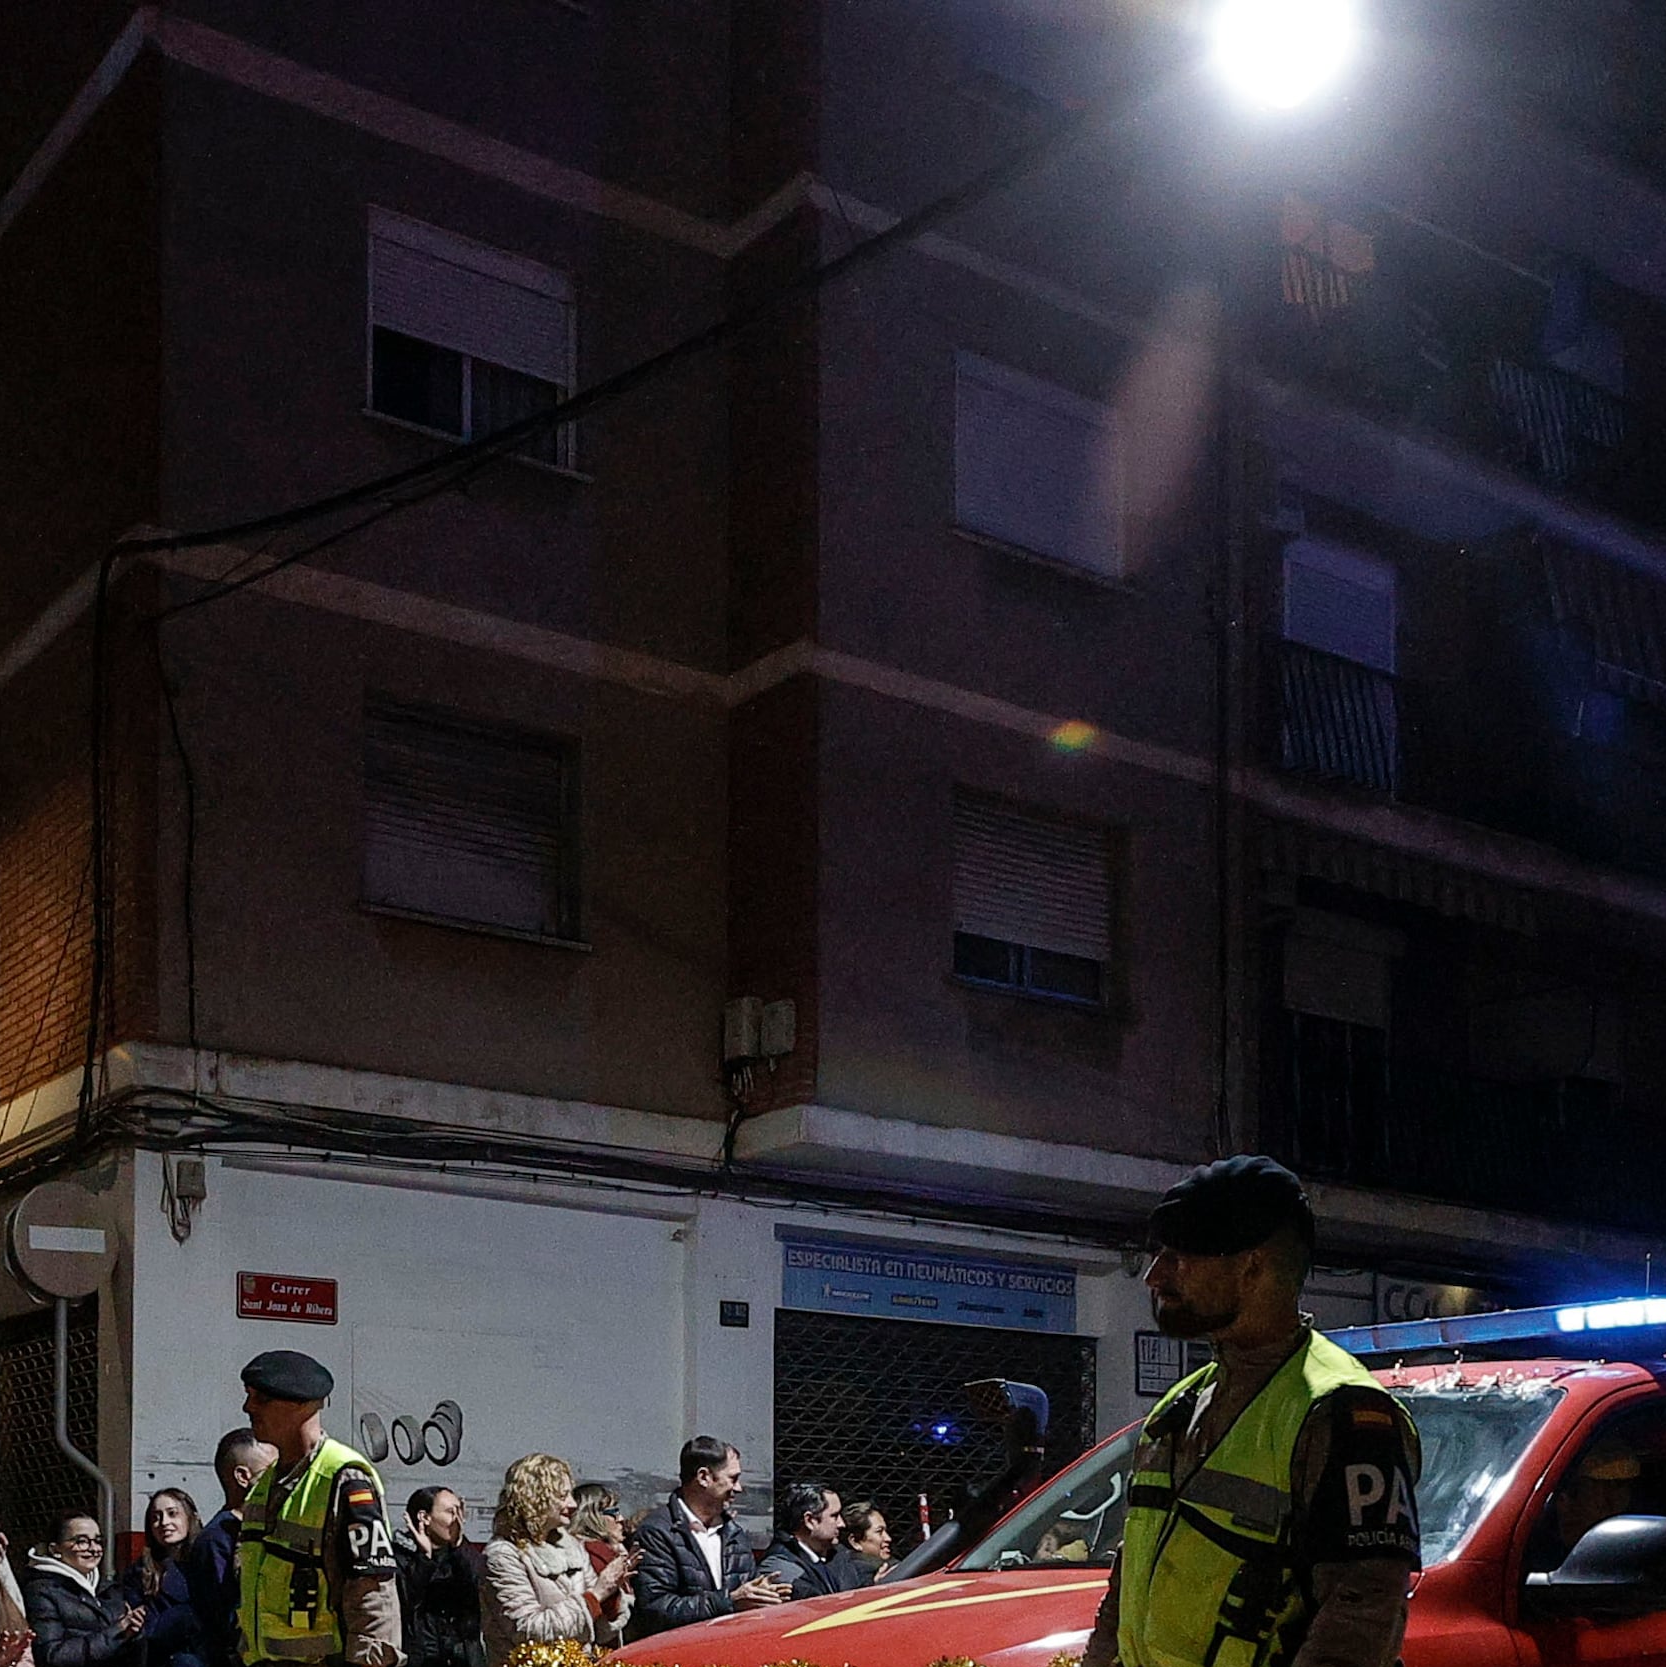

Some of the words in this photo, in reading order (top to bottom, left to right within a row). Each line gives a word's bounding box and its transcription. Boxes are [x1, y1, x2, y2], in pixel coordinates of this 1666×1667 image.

[787, 1248, 881, 1275] ESPECIALISTA
[996, 1272, 1007, 1288] Y
[266, 1300, 288, 1312] Joan
[291, 1302, 302, 1313] de
[305, 1302, 333, 1316] Ribera
[271, 1282, 312, 1296] Carrer
[1344, 1463, 1419, 1538] PA
[347, 1519, 395, 1559] PA
